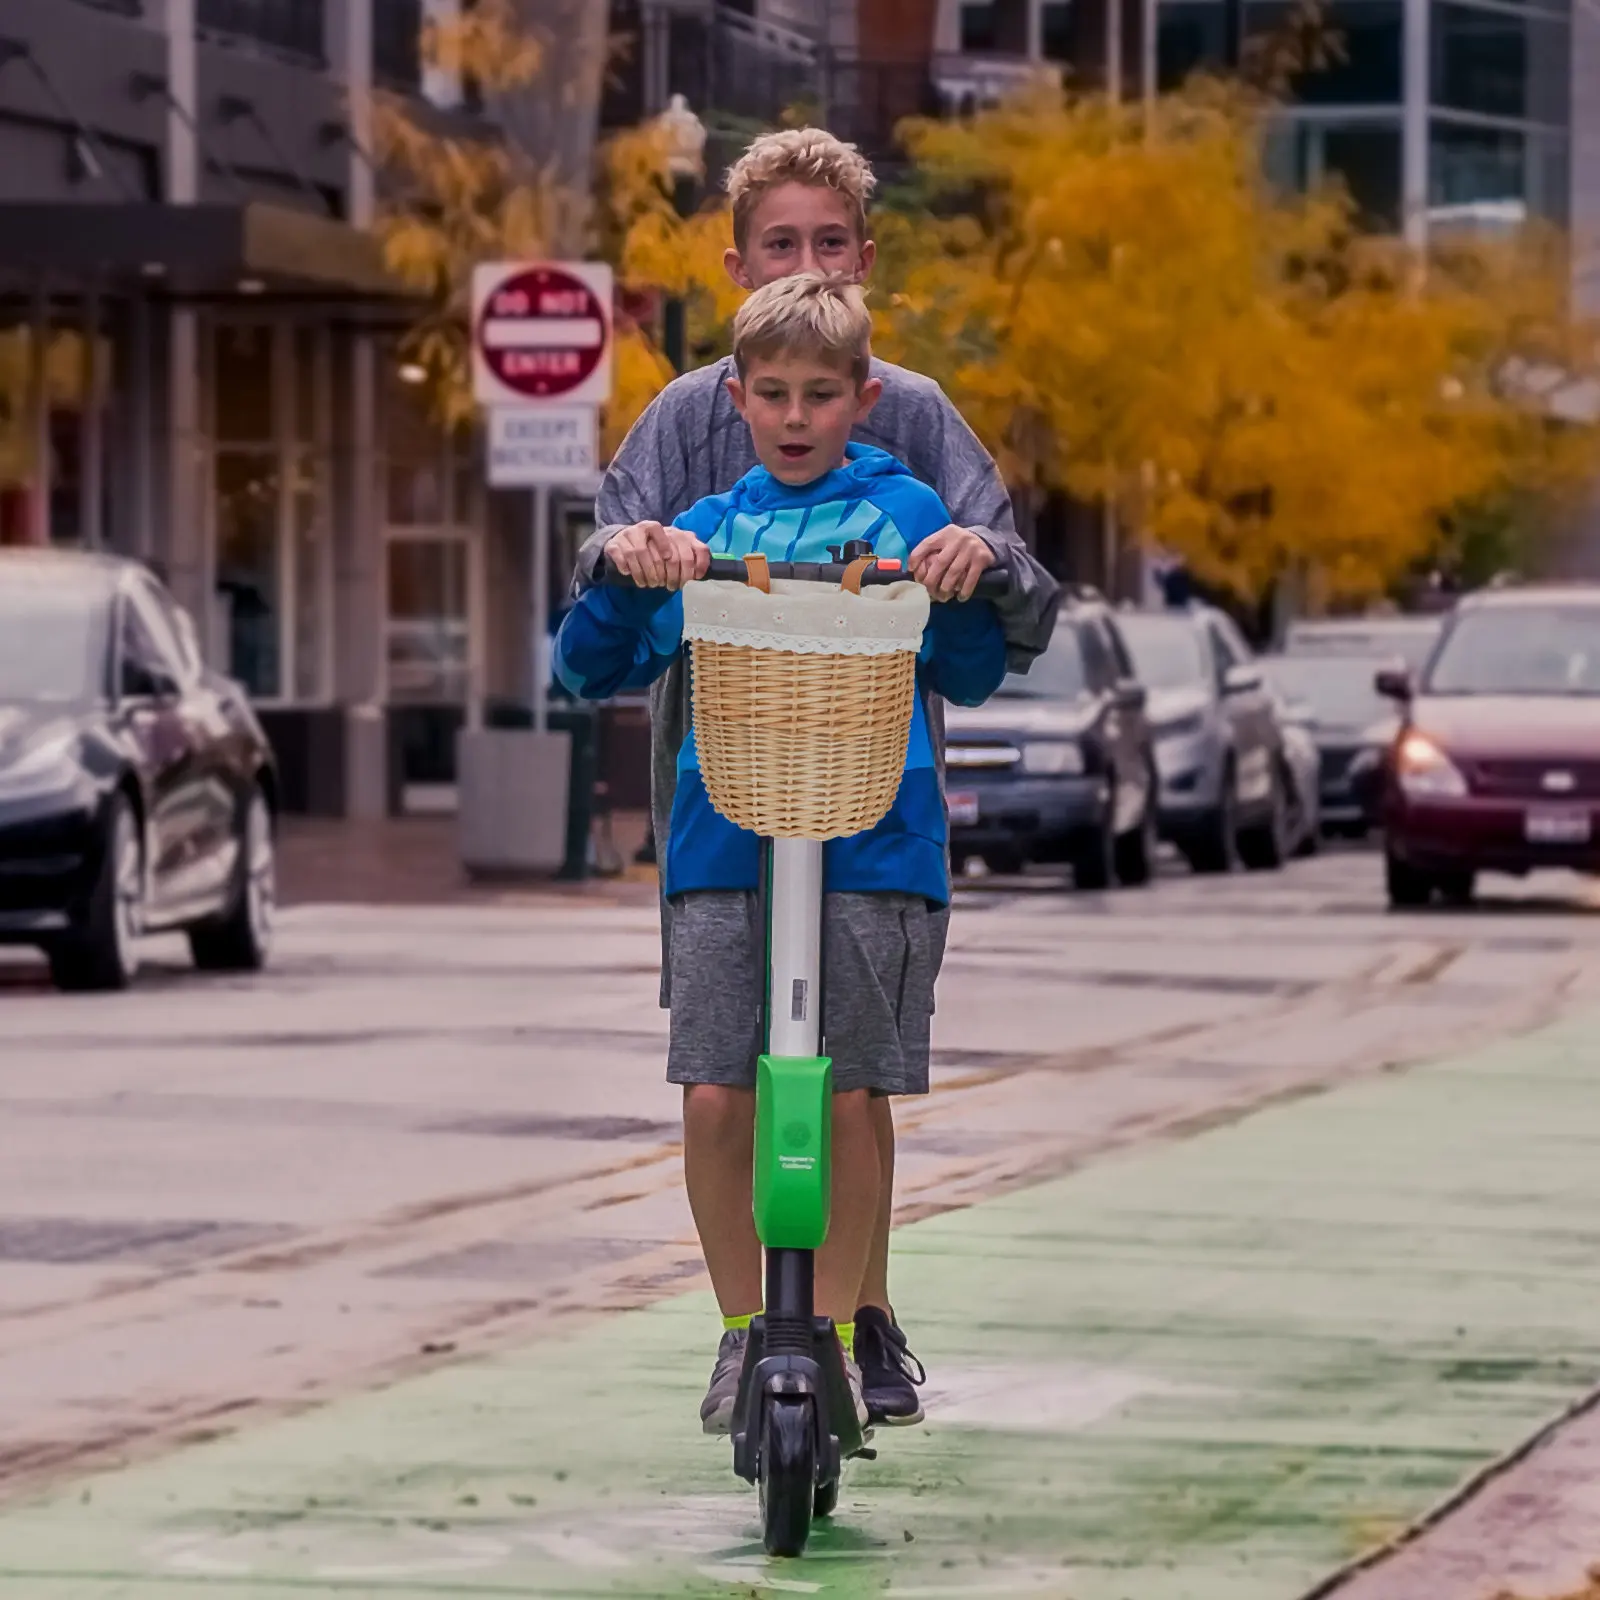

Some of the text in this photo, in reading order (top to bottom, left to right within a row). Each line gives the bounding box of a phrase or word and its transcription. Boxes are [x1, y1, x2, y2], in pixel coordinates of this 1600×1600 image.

[494, 290, 588, 315] DO NOT
[503, 352, 580, 375] ENTER
[504, 419, 577, 440] EXCEPT
[493, 447, 590, 467] BICYCLES
